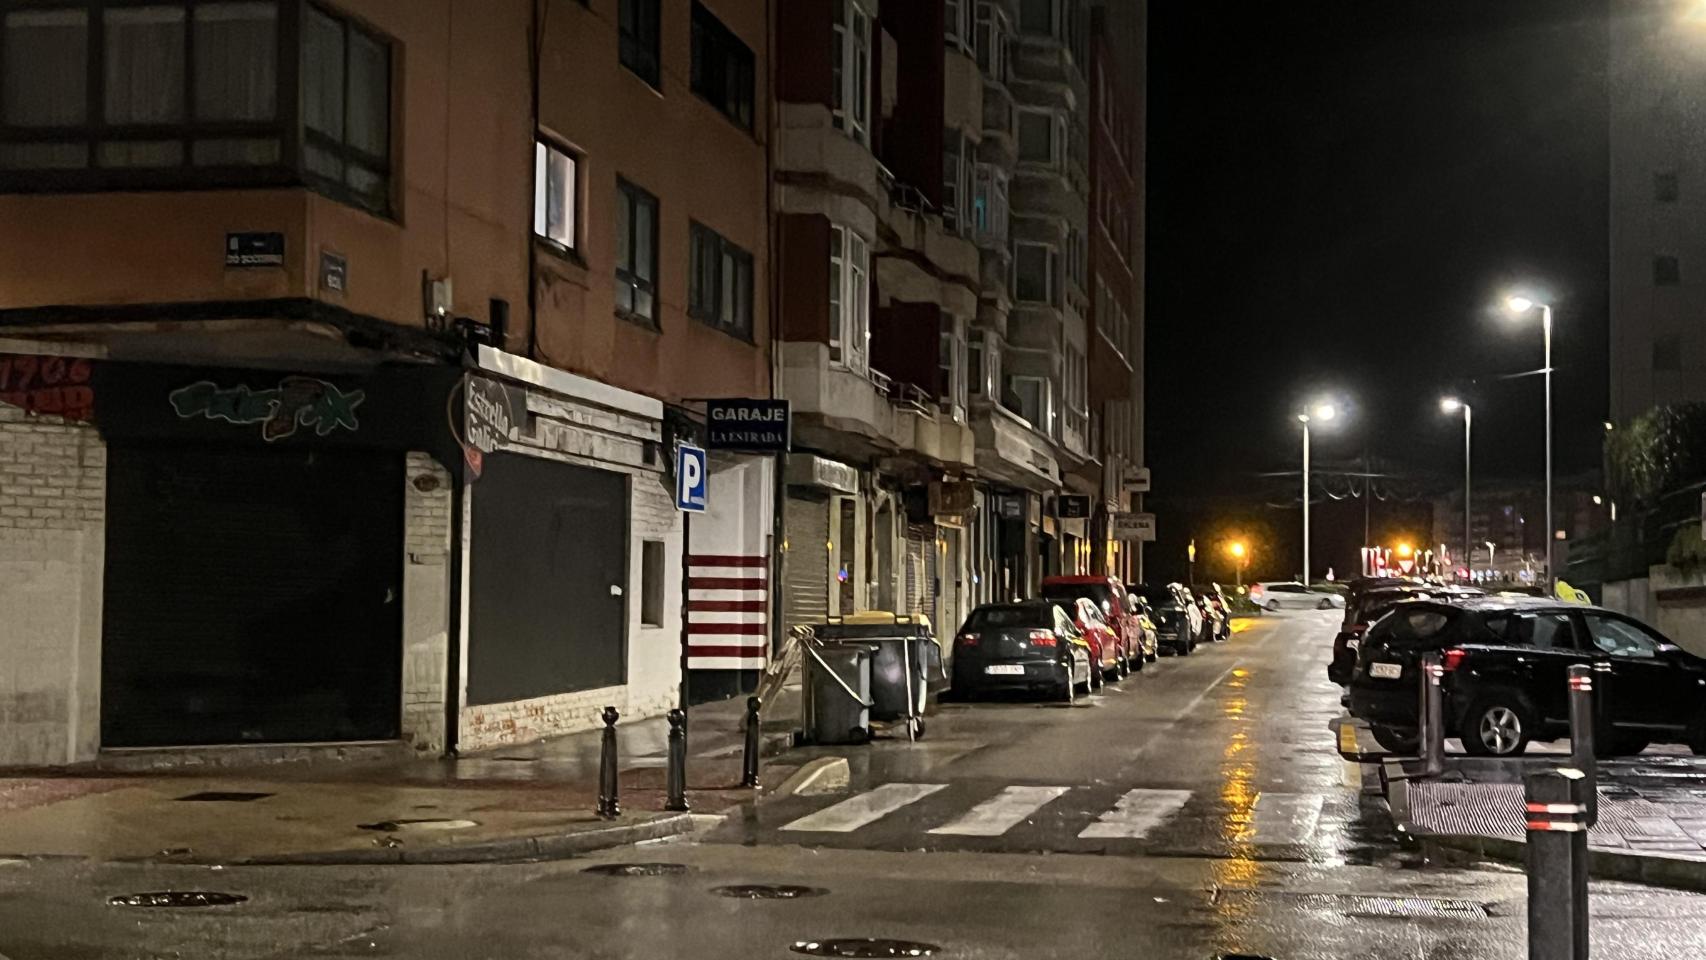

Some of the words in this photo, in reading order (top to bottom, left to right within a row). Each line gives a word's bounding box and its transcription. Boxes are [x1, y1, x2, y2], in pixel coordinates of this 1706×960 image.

[711, 407, 785, 421] GARAJE
[711, 431, 726, 442] LA
[729, 431, 783, 443] ESTRADA
[682, 453, 701, 504] P
